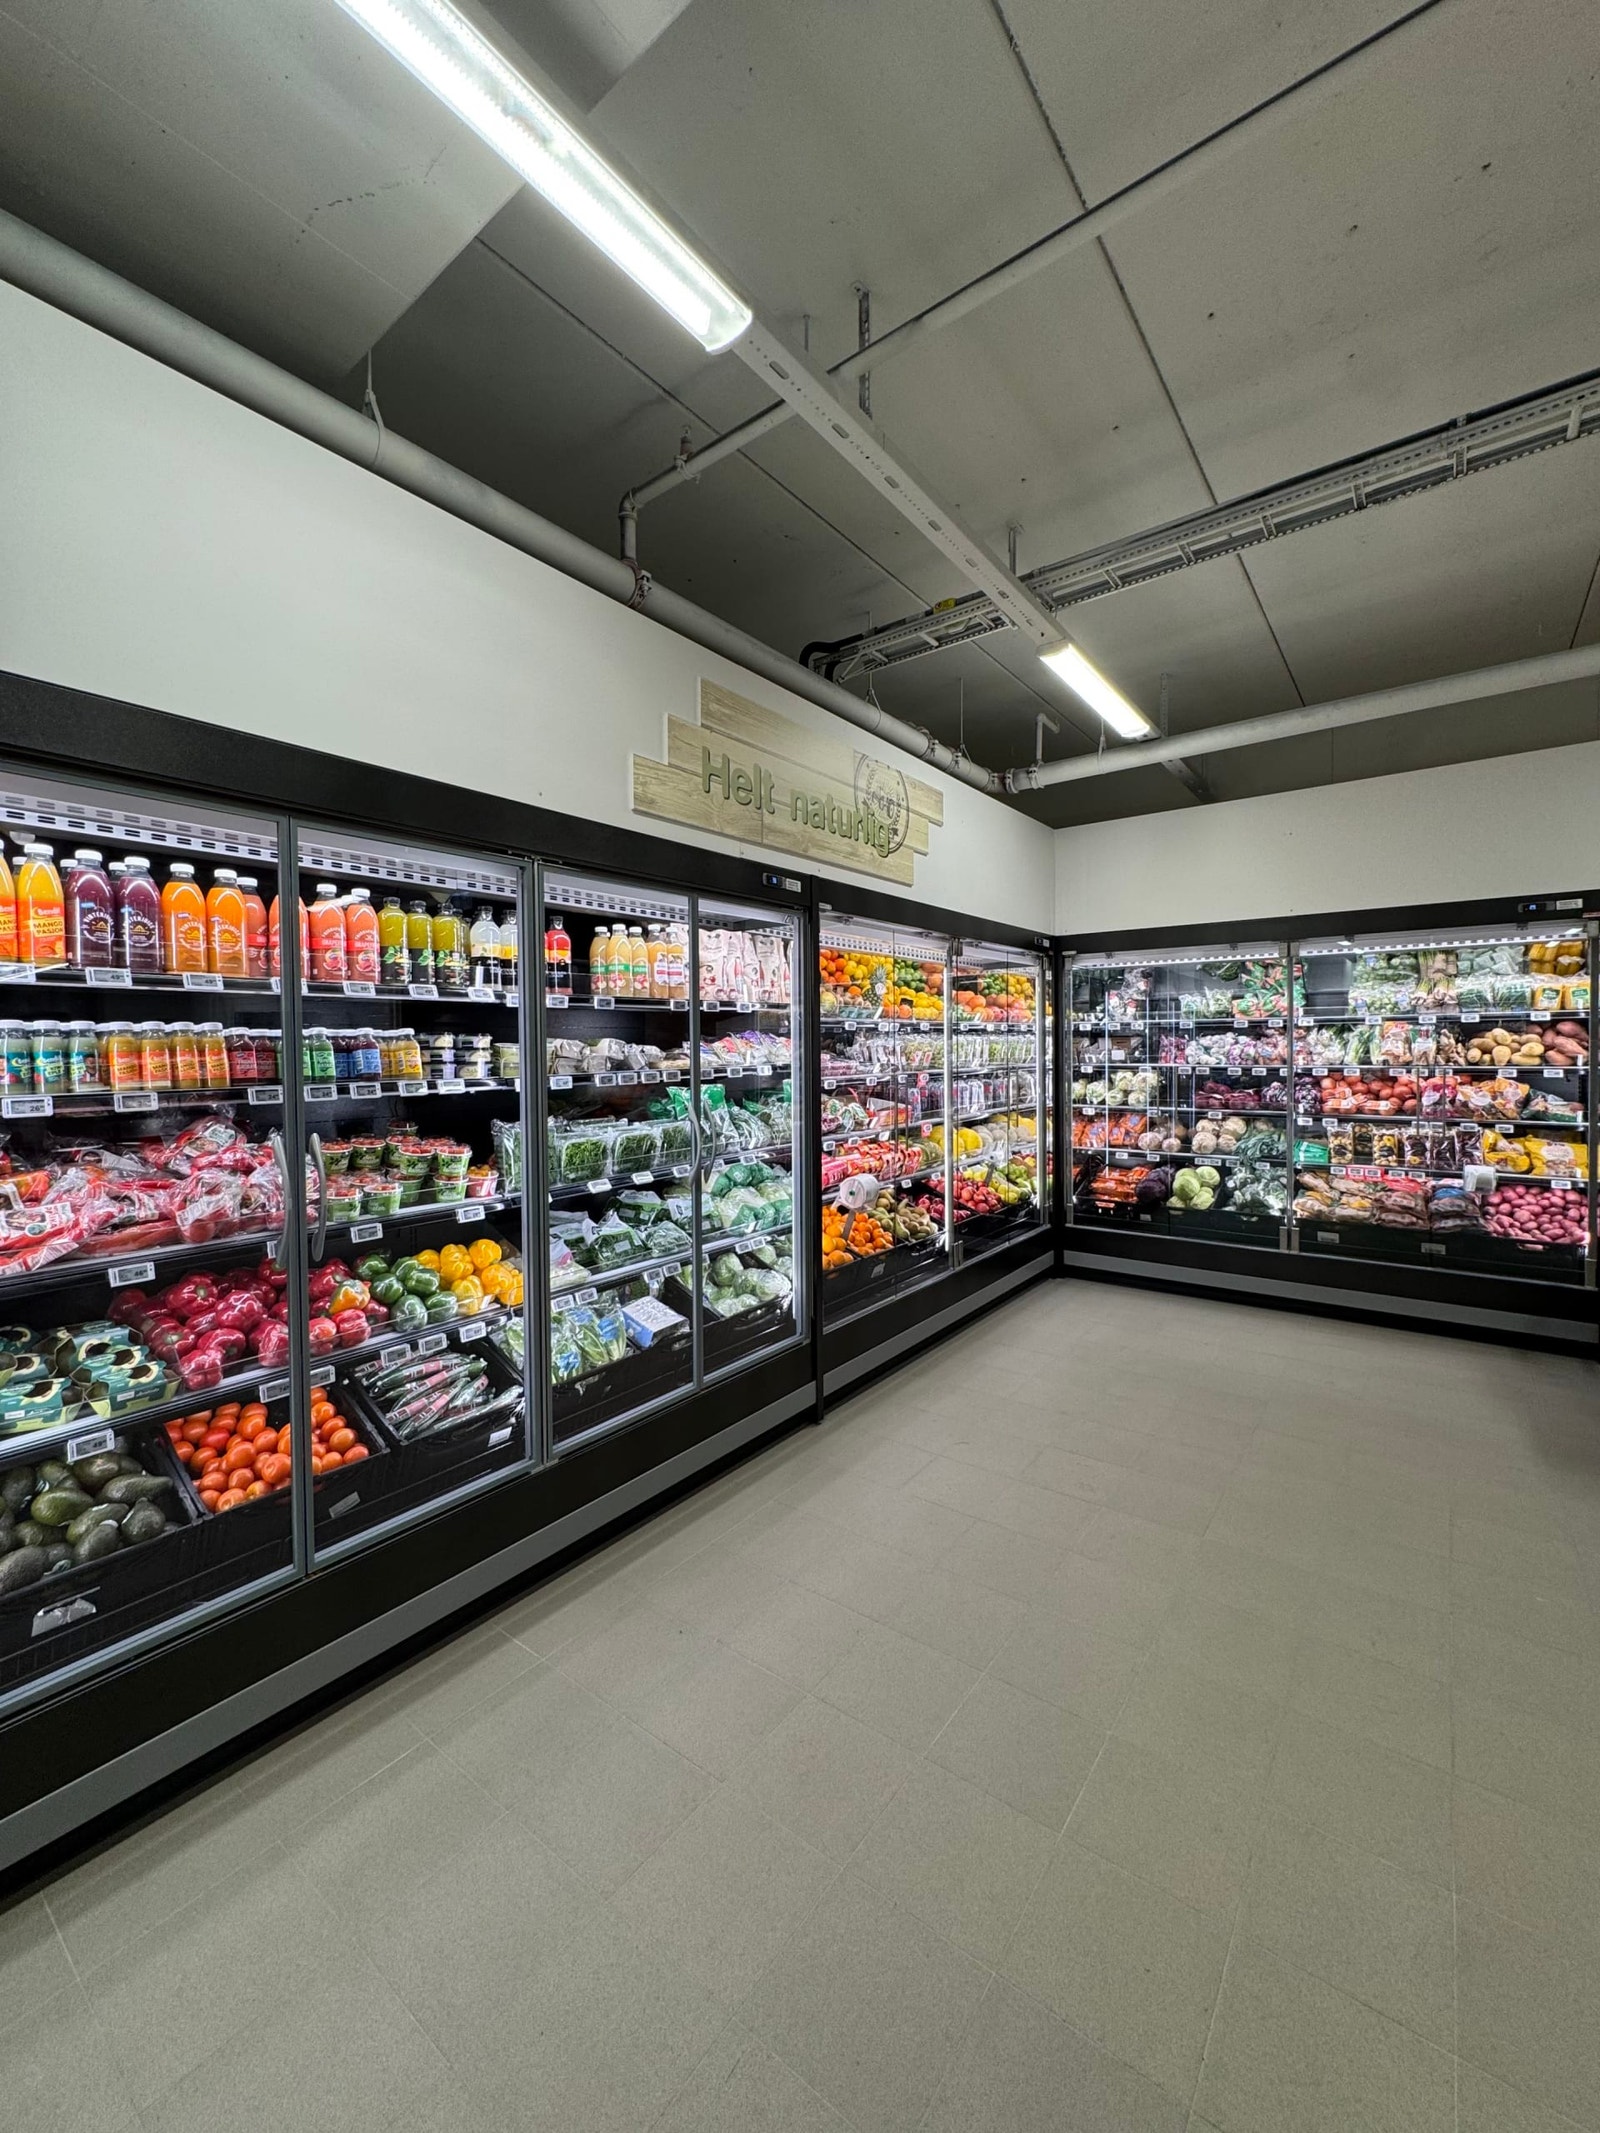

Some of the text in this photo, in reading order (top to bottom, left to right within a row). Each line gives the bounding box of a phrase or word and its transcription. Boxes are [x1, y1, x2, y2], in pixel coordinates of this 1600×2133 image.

[701, 746, 776, 814] Helt
[789, 788, 891, 859] naturlig
[33, 920, 63, 929] MANGO
